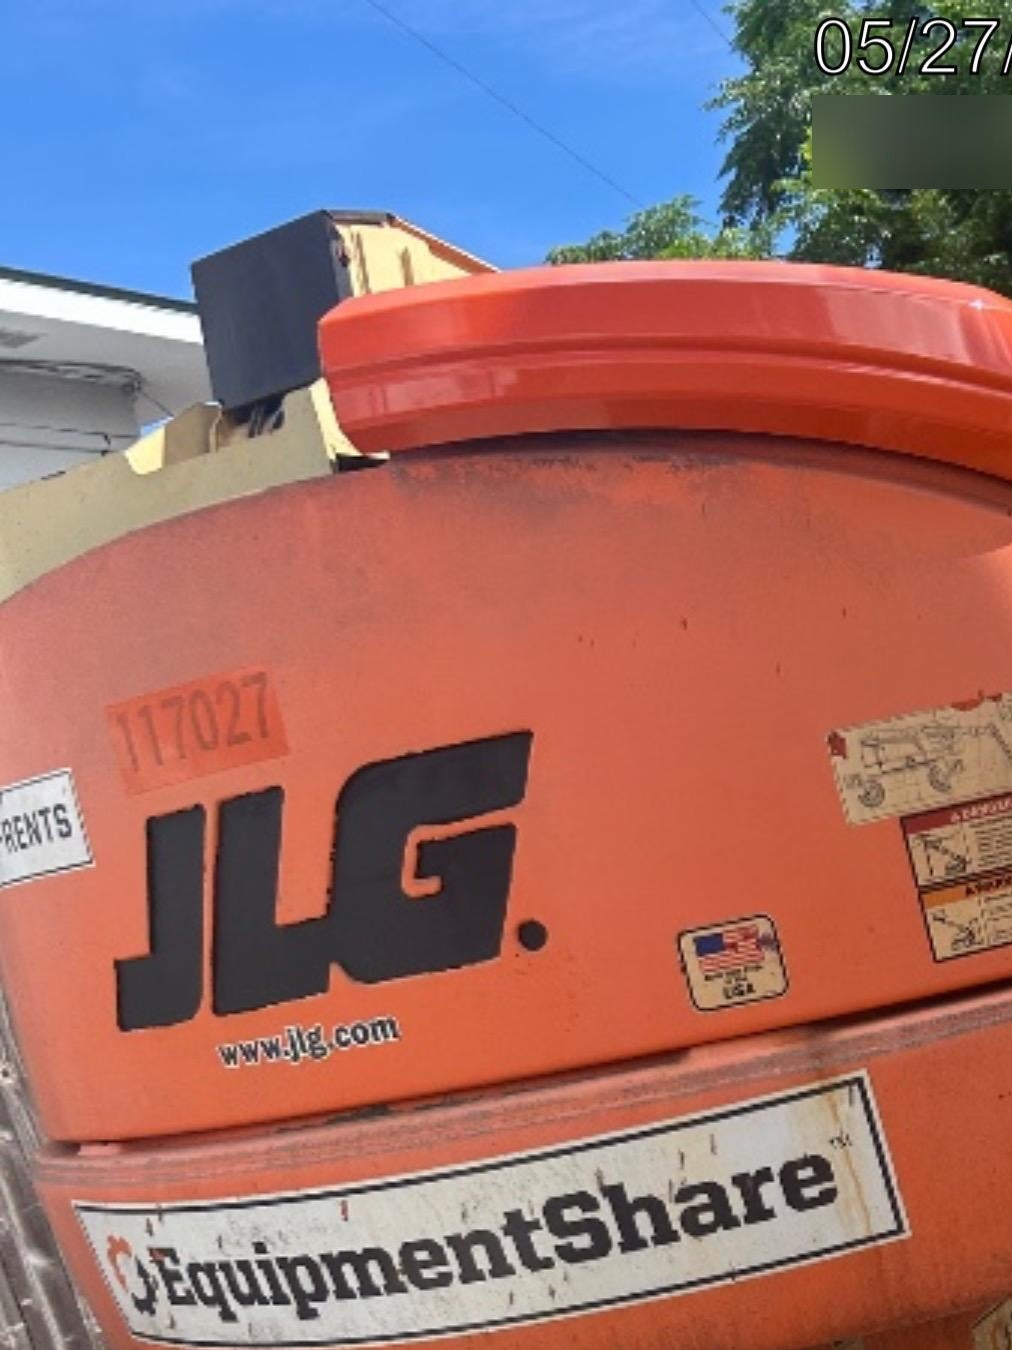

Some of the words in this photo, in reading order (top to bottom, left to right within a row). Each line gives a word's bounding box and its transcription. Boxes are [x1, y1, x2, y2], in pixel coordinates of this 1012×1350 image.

[116, 672, 270, 773] 117027
[218, 1017, 400, 1068] www.jlg.com
[155, 1150, 837, 1323] EquipmentShare
